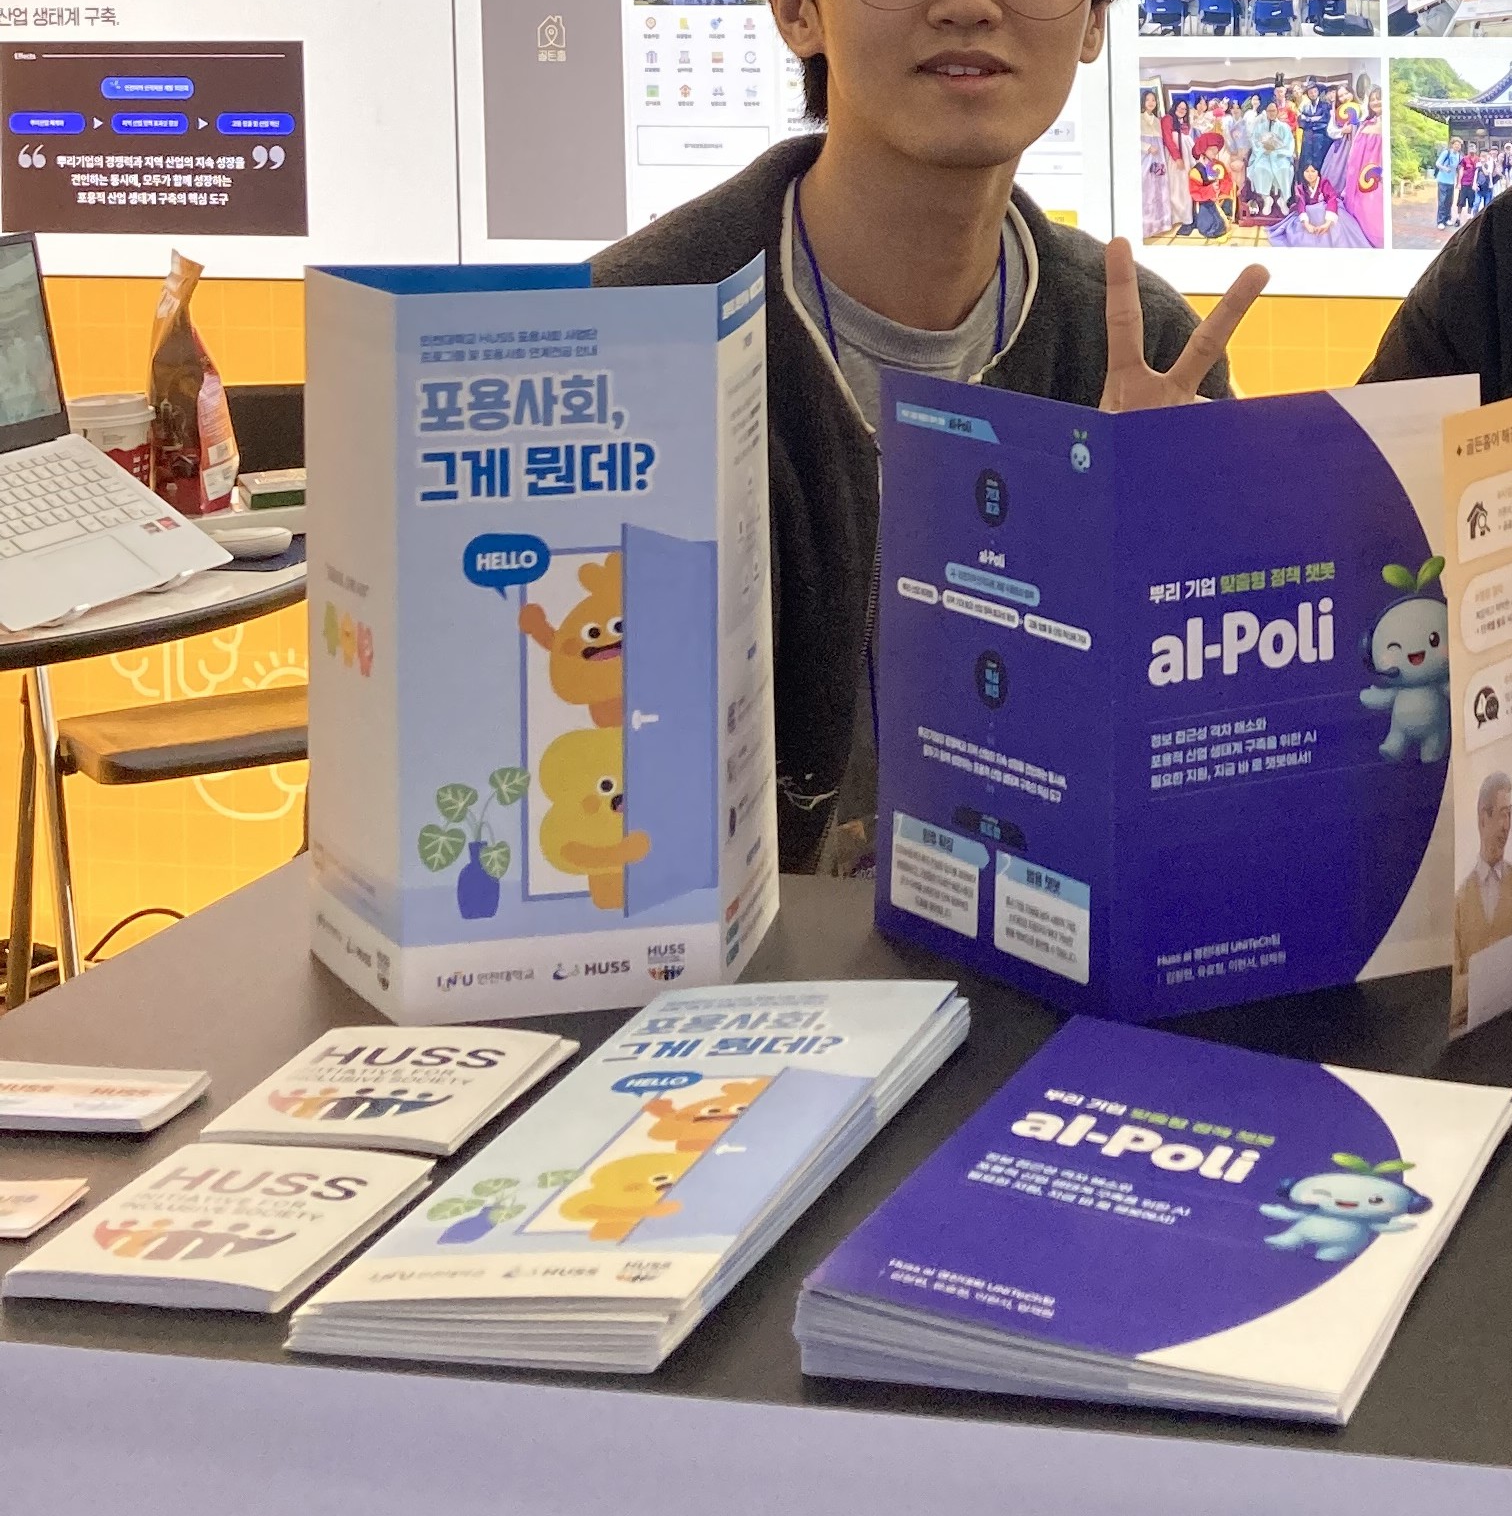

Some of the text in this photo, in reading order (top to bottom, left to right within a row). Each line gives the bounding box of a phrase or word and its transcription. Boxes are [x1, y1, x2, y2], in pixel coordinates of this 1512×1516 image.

[420, 374, 624, 432] 포용사회,
[421, 443, 655, 502] 그게 뭔데?
[476, 550, 538, 571] HELLO
[1149, 581, 1180, 603] 뿌리
[1184, 577, 1216, 599] 기업
[648, 943, 685, 956] HUSS
[584, 960, 631, 976] HUSS
[312, 1045, 506, 1069] HUSS
[625, 1076, 688, 1088] HELLO
[149, 1167, 369, 1201] HUSS
